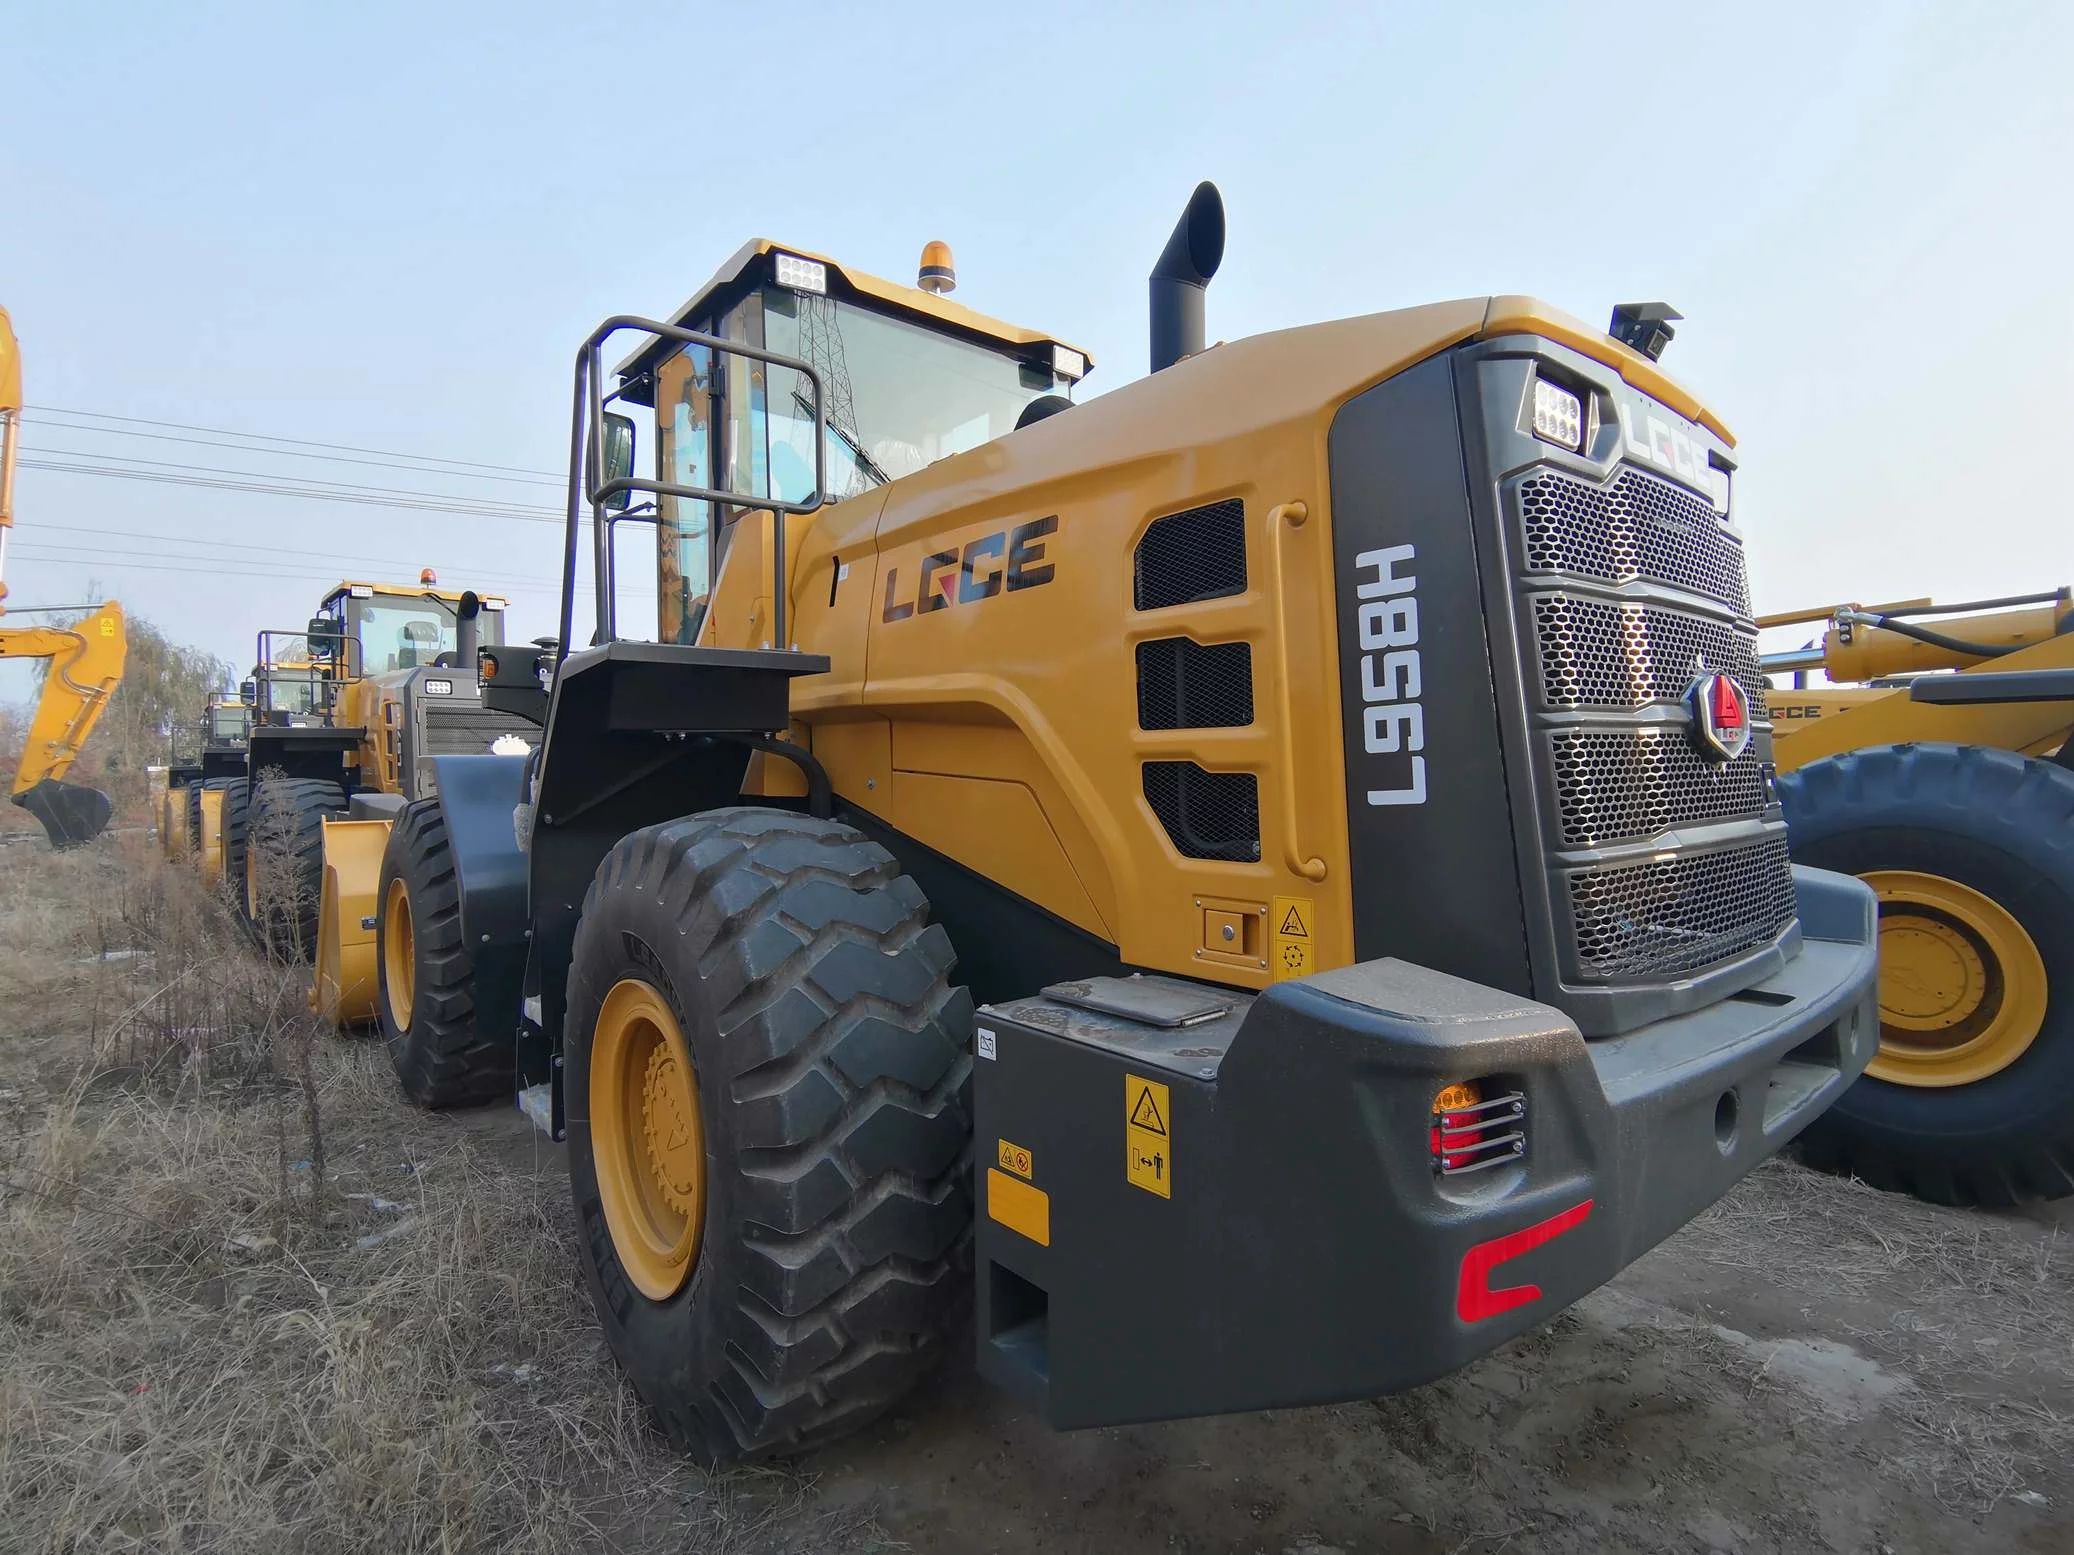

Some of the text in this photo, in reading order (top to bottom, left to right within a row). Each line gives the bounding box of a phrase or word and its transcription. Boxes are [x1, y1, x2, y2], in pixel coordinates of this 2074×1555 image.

[883, 515, 1058, 624] LGCE
[1355, 543, 1427, 806] L958H
[1769, 705, 1822, 720] GCE
